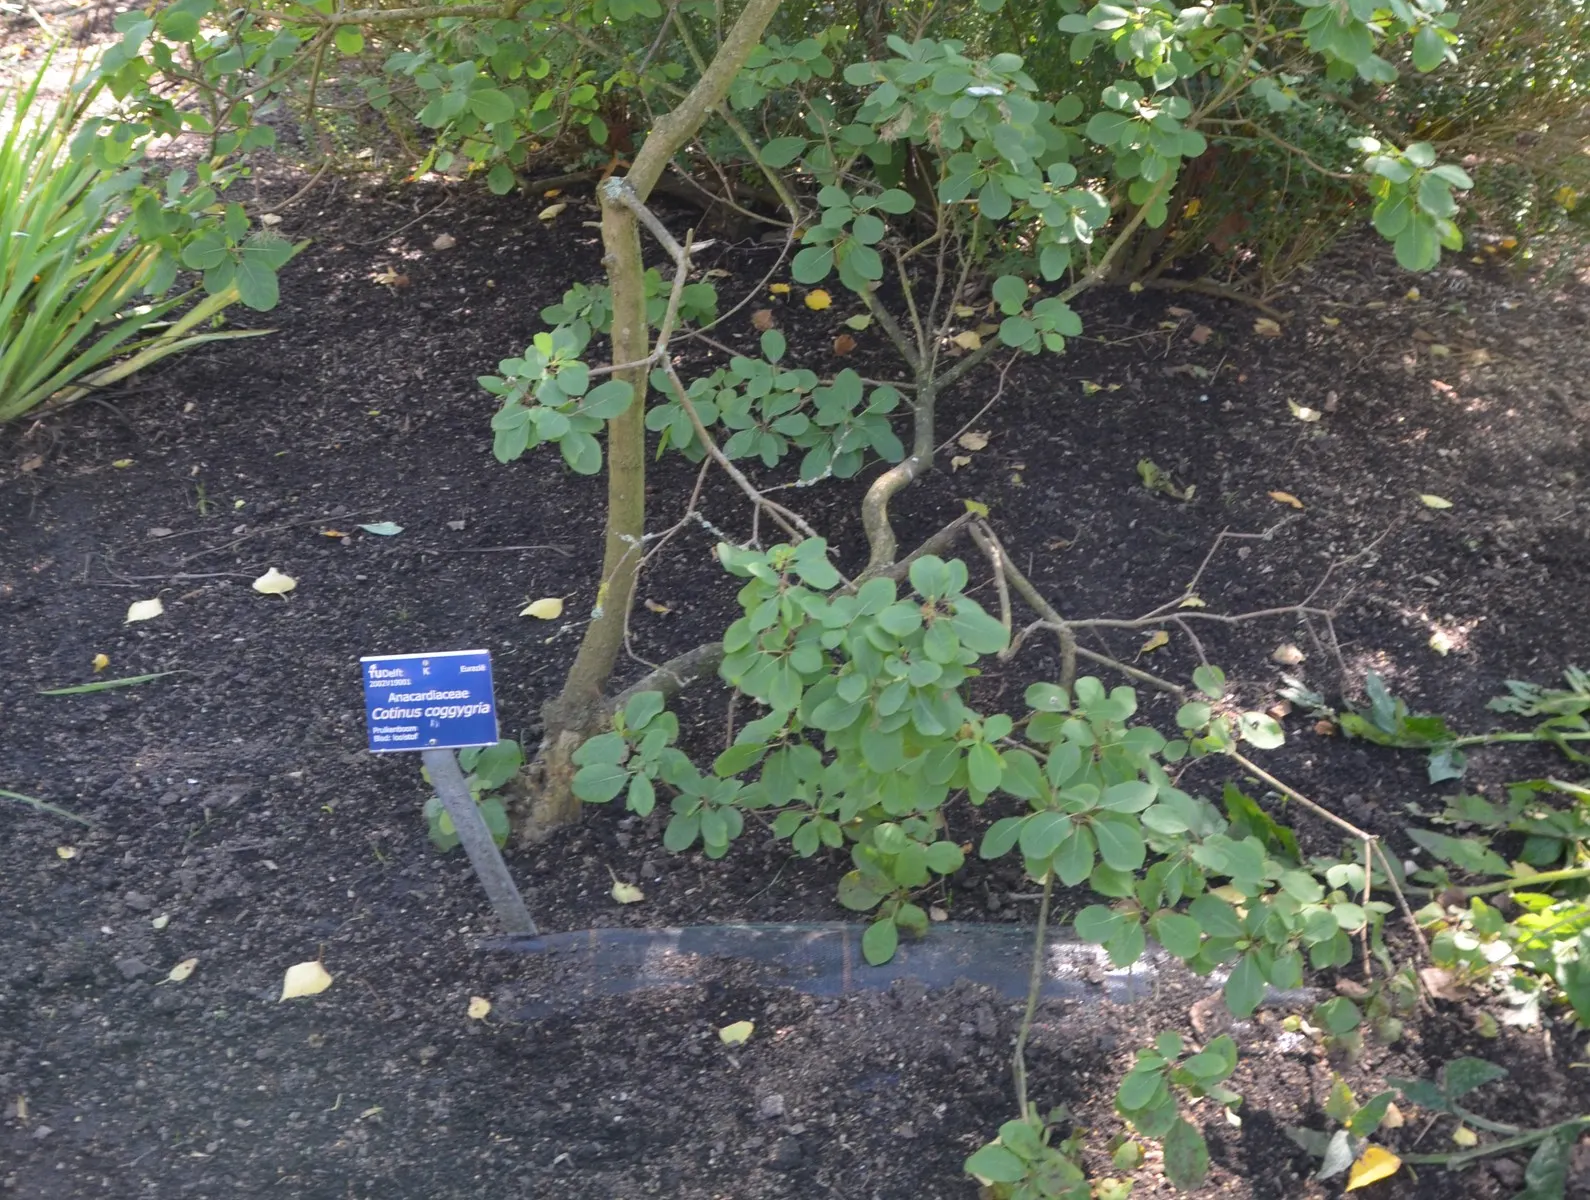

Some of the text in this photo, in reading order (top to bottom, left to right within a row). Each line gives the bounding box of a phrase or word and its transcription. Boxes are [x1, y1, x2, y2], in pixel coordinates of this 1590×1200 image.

[388, 689, 471, 704] Anacardiaceae
[371, 701, 492, 720] Cotinus coggygria
